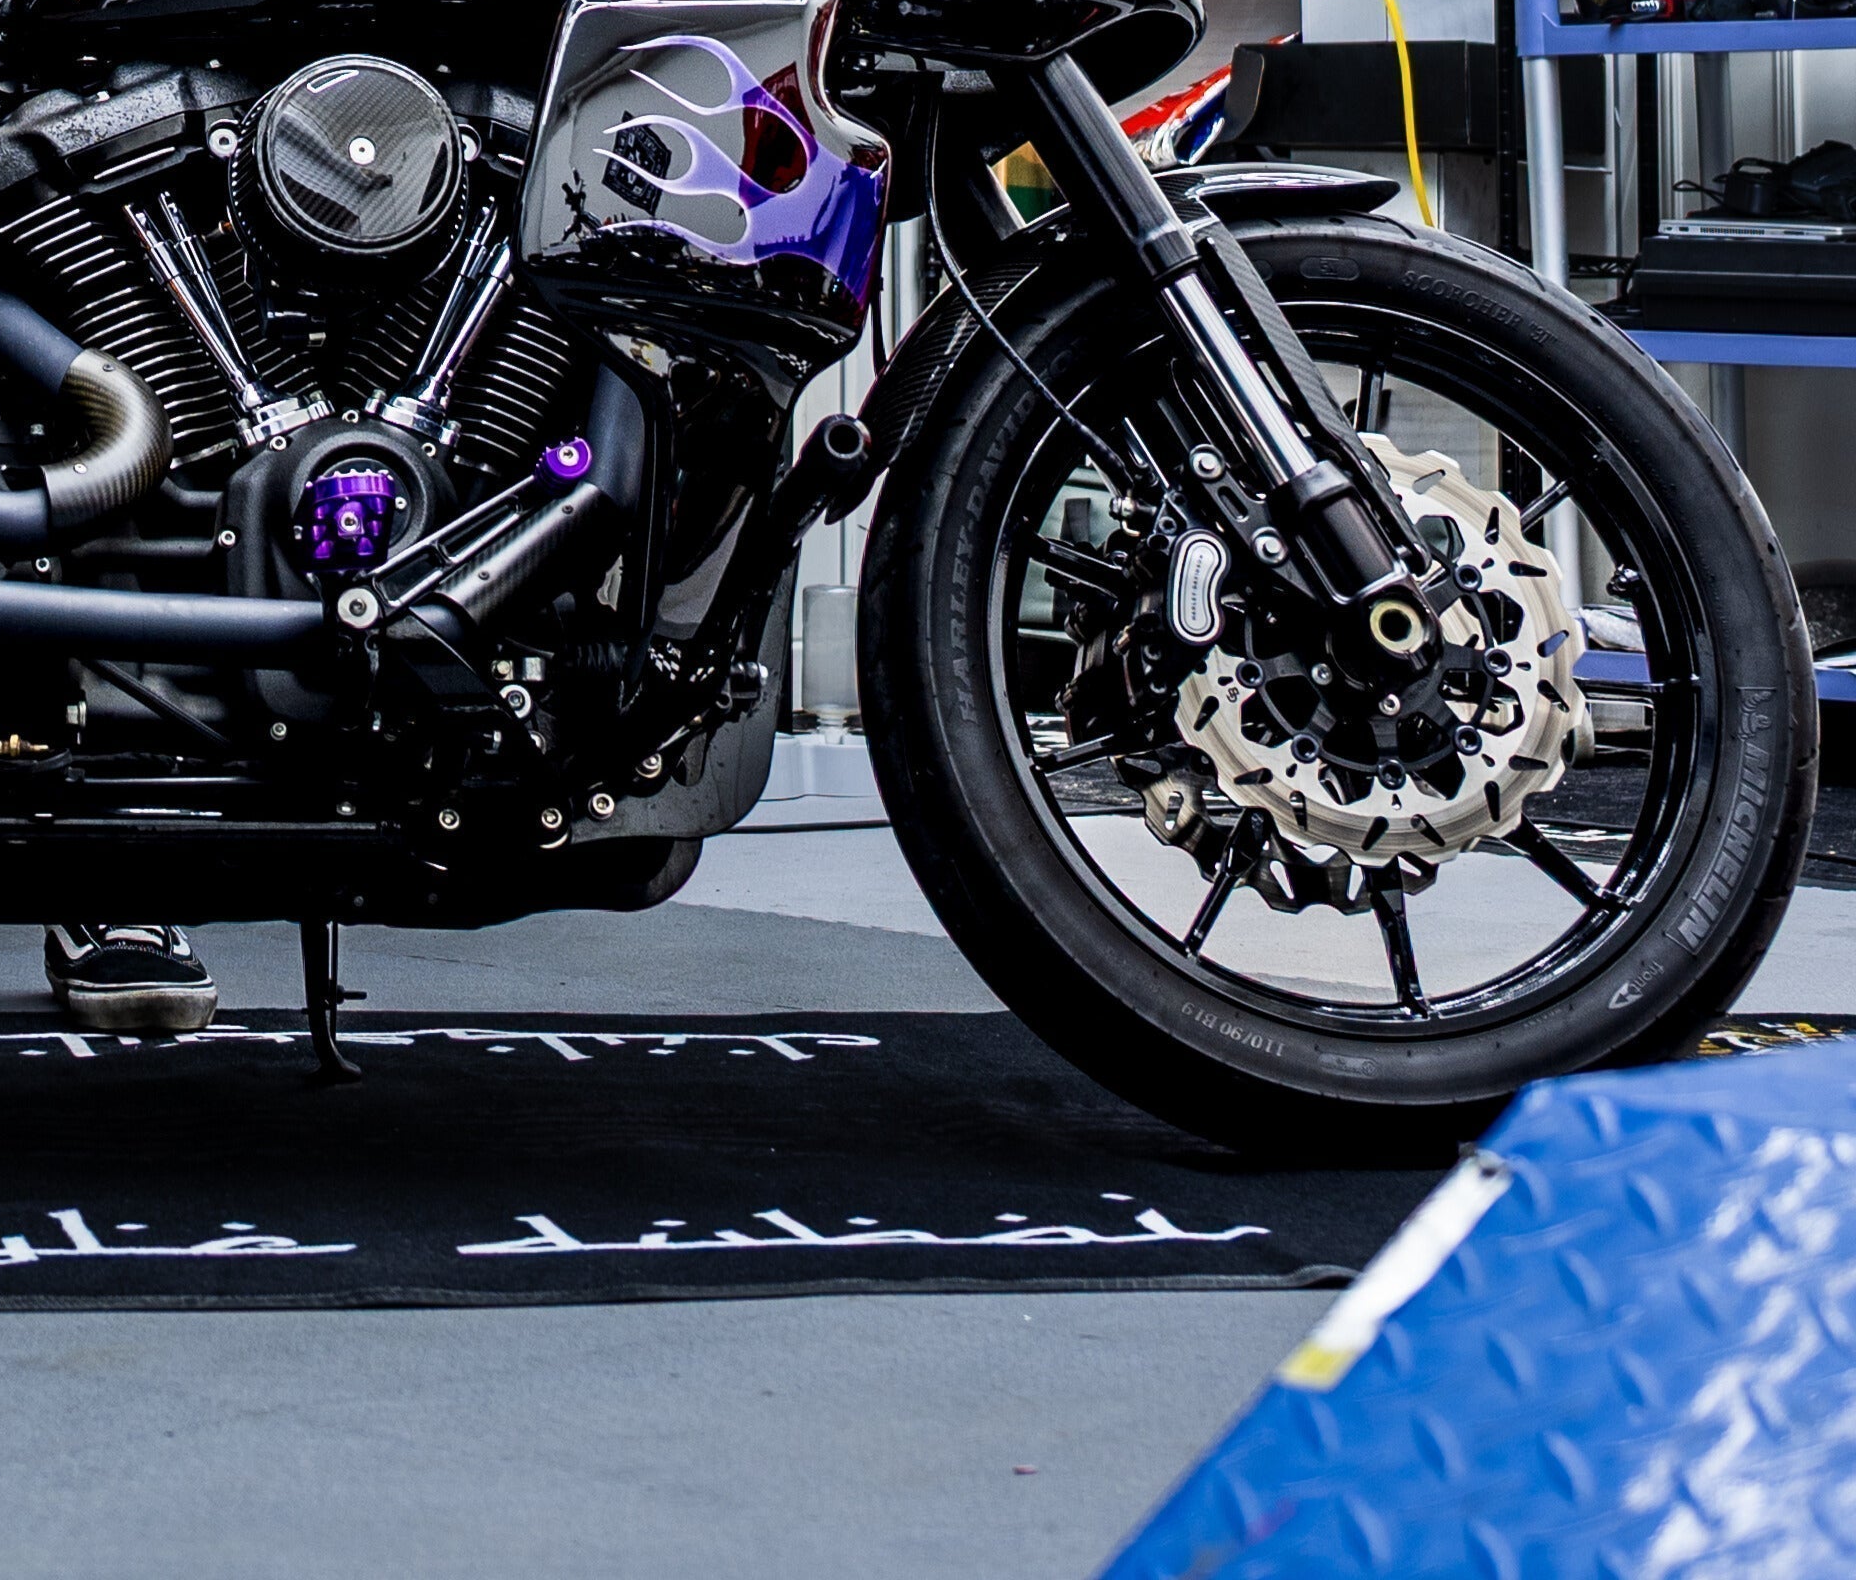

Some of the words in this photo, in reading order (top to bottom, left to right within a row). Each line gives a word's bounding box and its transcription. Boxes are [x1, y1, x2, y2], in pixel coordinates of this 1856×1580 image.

[1401, 269, 1524, 334] SCORCHER
[1676, 741, 1771, 950] MICHELIN
[1219, 1021, 1287, 1057] 110/90
